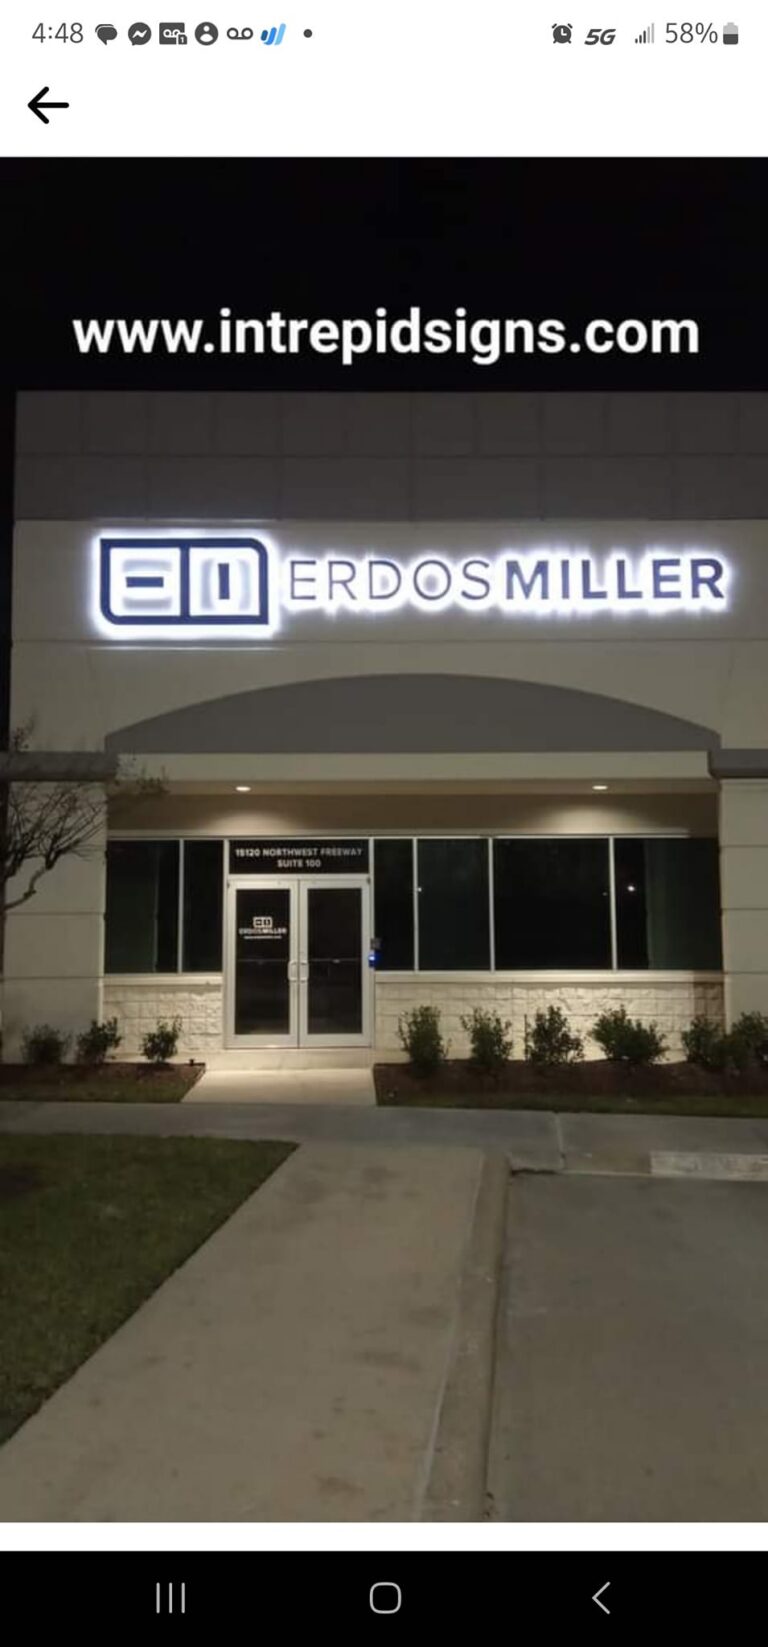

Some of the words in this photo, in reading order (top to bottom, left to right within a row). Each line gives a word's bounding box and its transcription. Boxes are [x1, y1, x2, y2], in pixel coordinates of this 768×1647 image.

[32, 22, 83, 44] 4:48
[584, 28, 617, 46] 5G
[666, 22, 718, 44] 58%
[263, 848, 317, 857] NORTHWEST
[320, 848, 362, 856] FREEWAY
[277, 859, 303, 868] SUITE
[306, 859, 321, 868] 100
